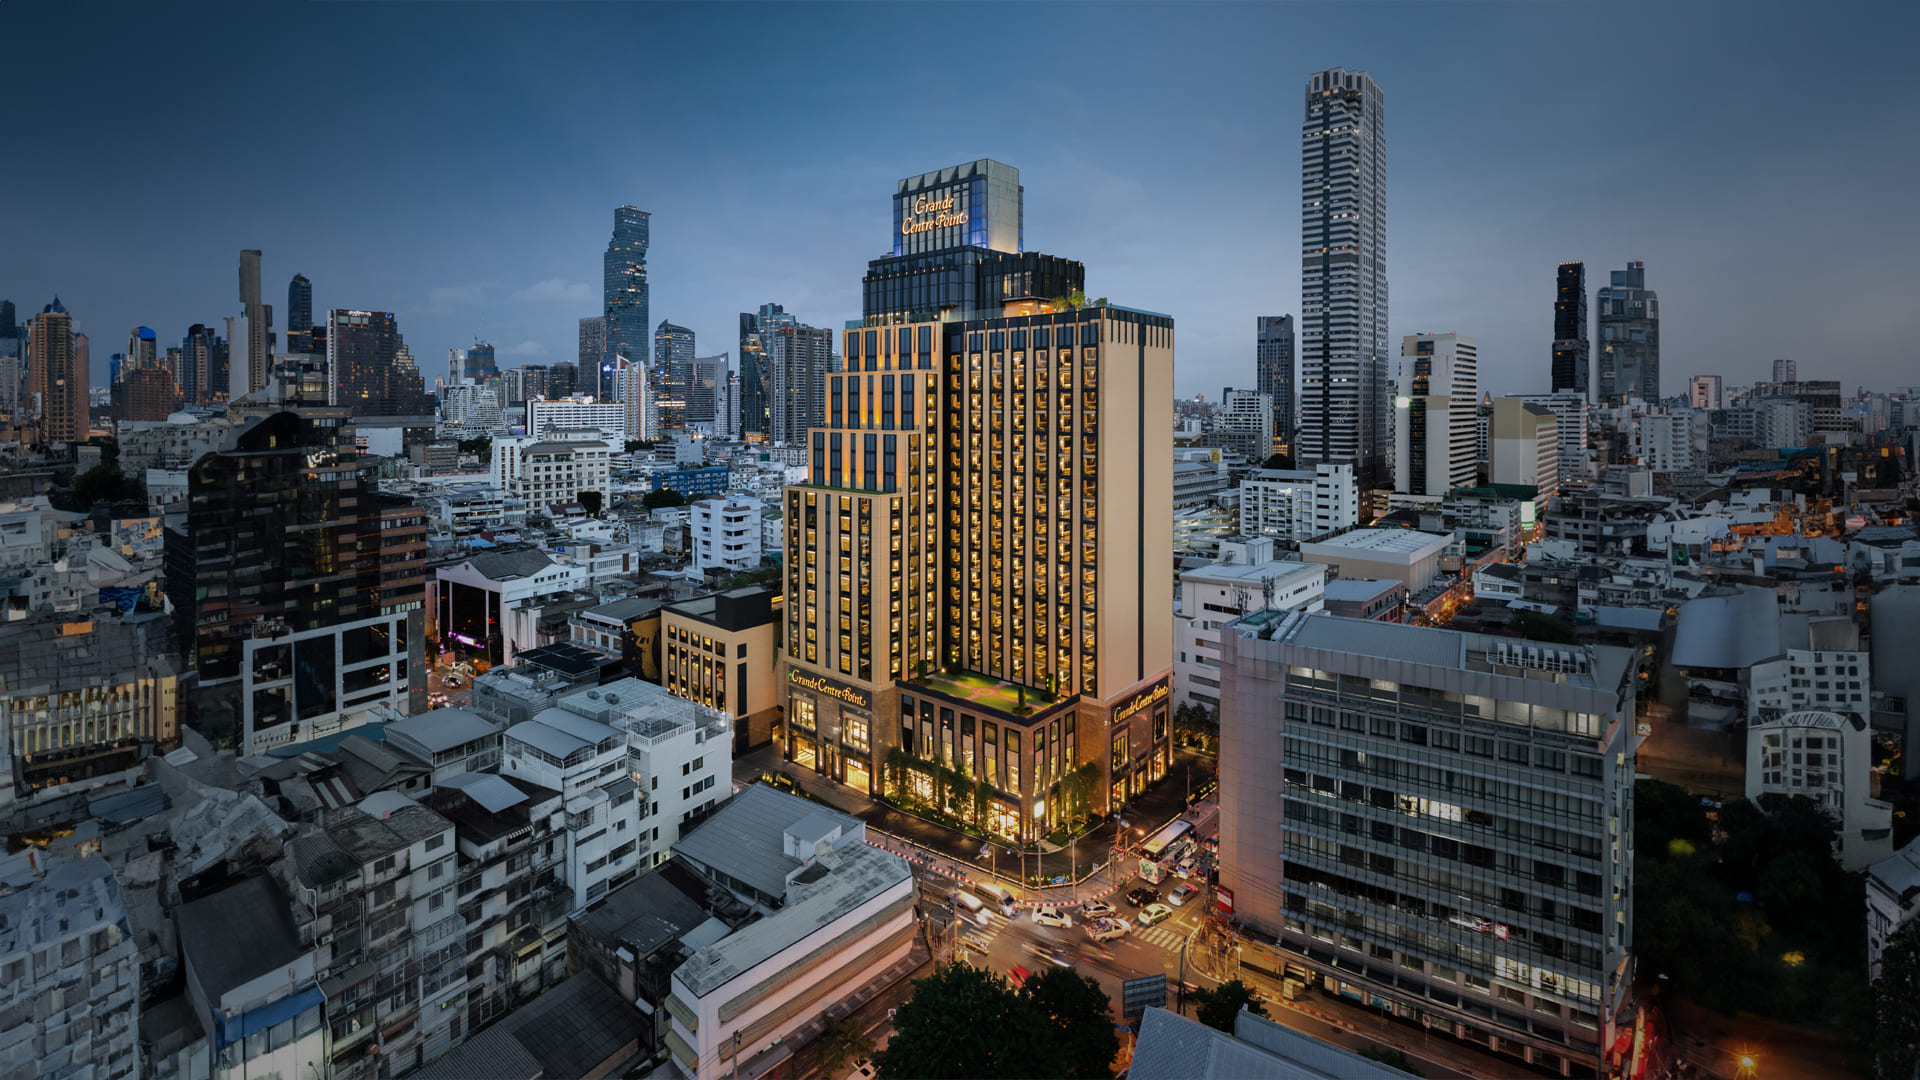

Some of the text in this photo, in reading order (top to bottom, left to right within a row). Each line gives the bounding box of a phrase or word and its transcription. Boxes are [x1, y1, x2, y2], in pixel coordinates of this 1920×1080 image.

[914, 193, 954, 215] Grande
[902, 209, 969, 235] Centre Point
[791, 669, 867, 706] Grande Centre Point
[1114, 684, 1169, 723] Grande Centre Point
